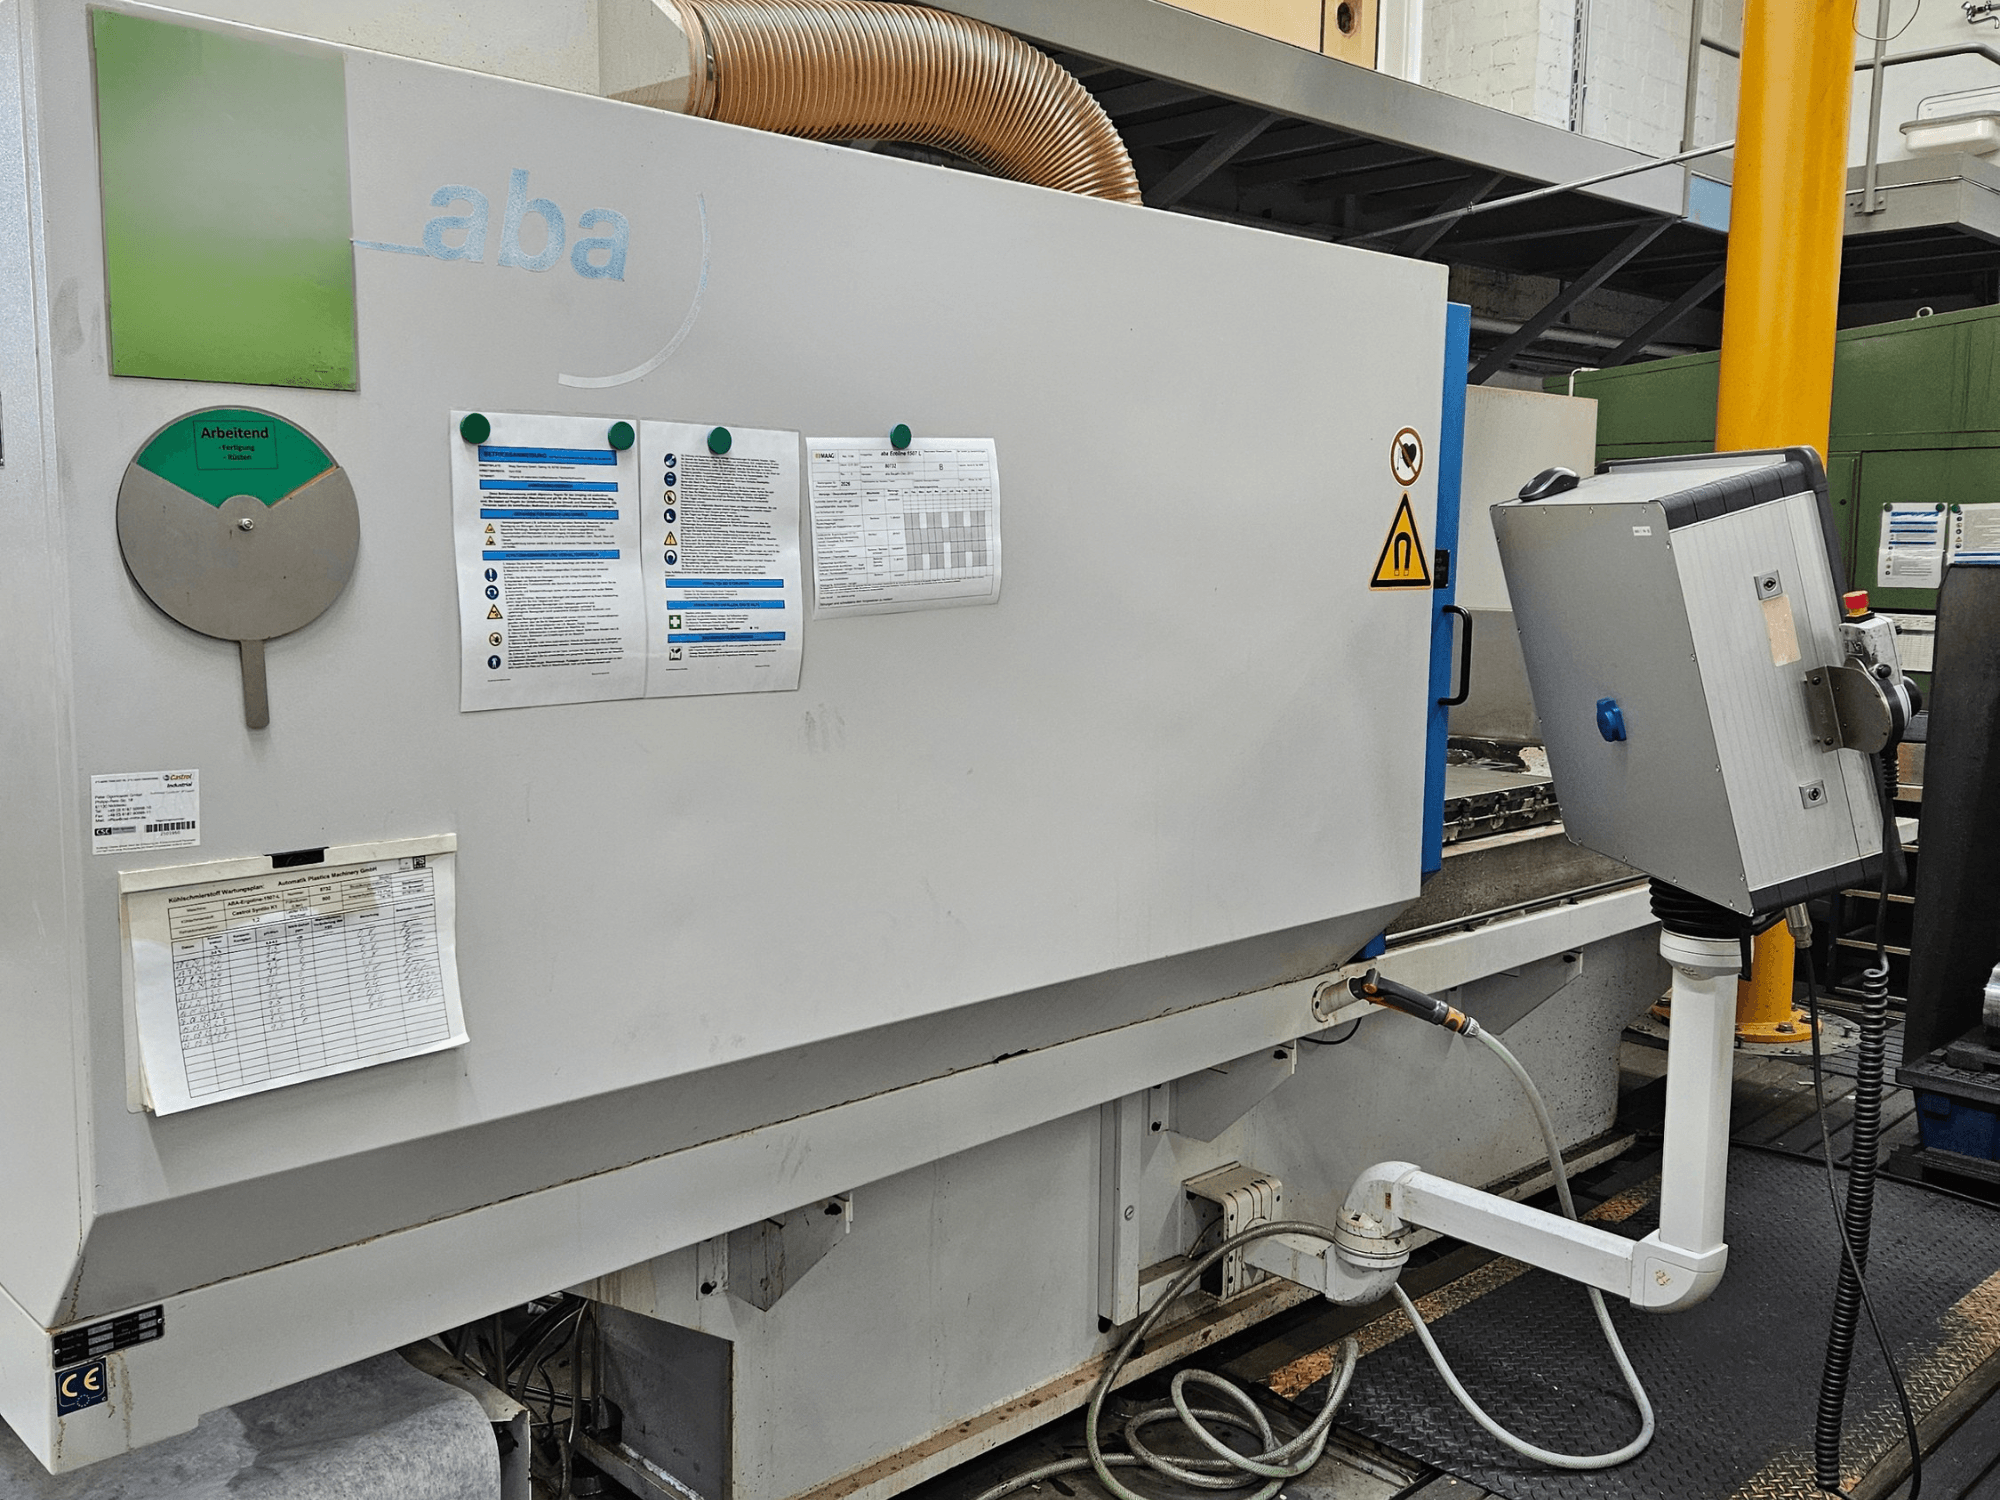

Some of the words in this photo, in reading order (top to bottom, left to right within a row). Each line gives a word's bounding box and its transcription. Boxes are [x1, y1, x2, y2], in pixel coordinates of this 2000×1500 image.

[422, 168, 630, 281] aba
[201, 427, 269, 439] Arbeitend
[278, 876, 307, 886] Automatik
[308, 872, 330, 882] Plastics
[331, 870, 359, 879] Machinery
[169, 890, 220, 903] Kühlschmierstoff
[222, 884, 265, 896] Wartungsplan:
[62, 1366, 100, 1398] CE
